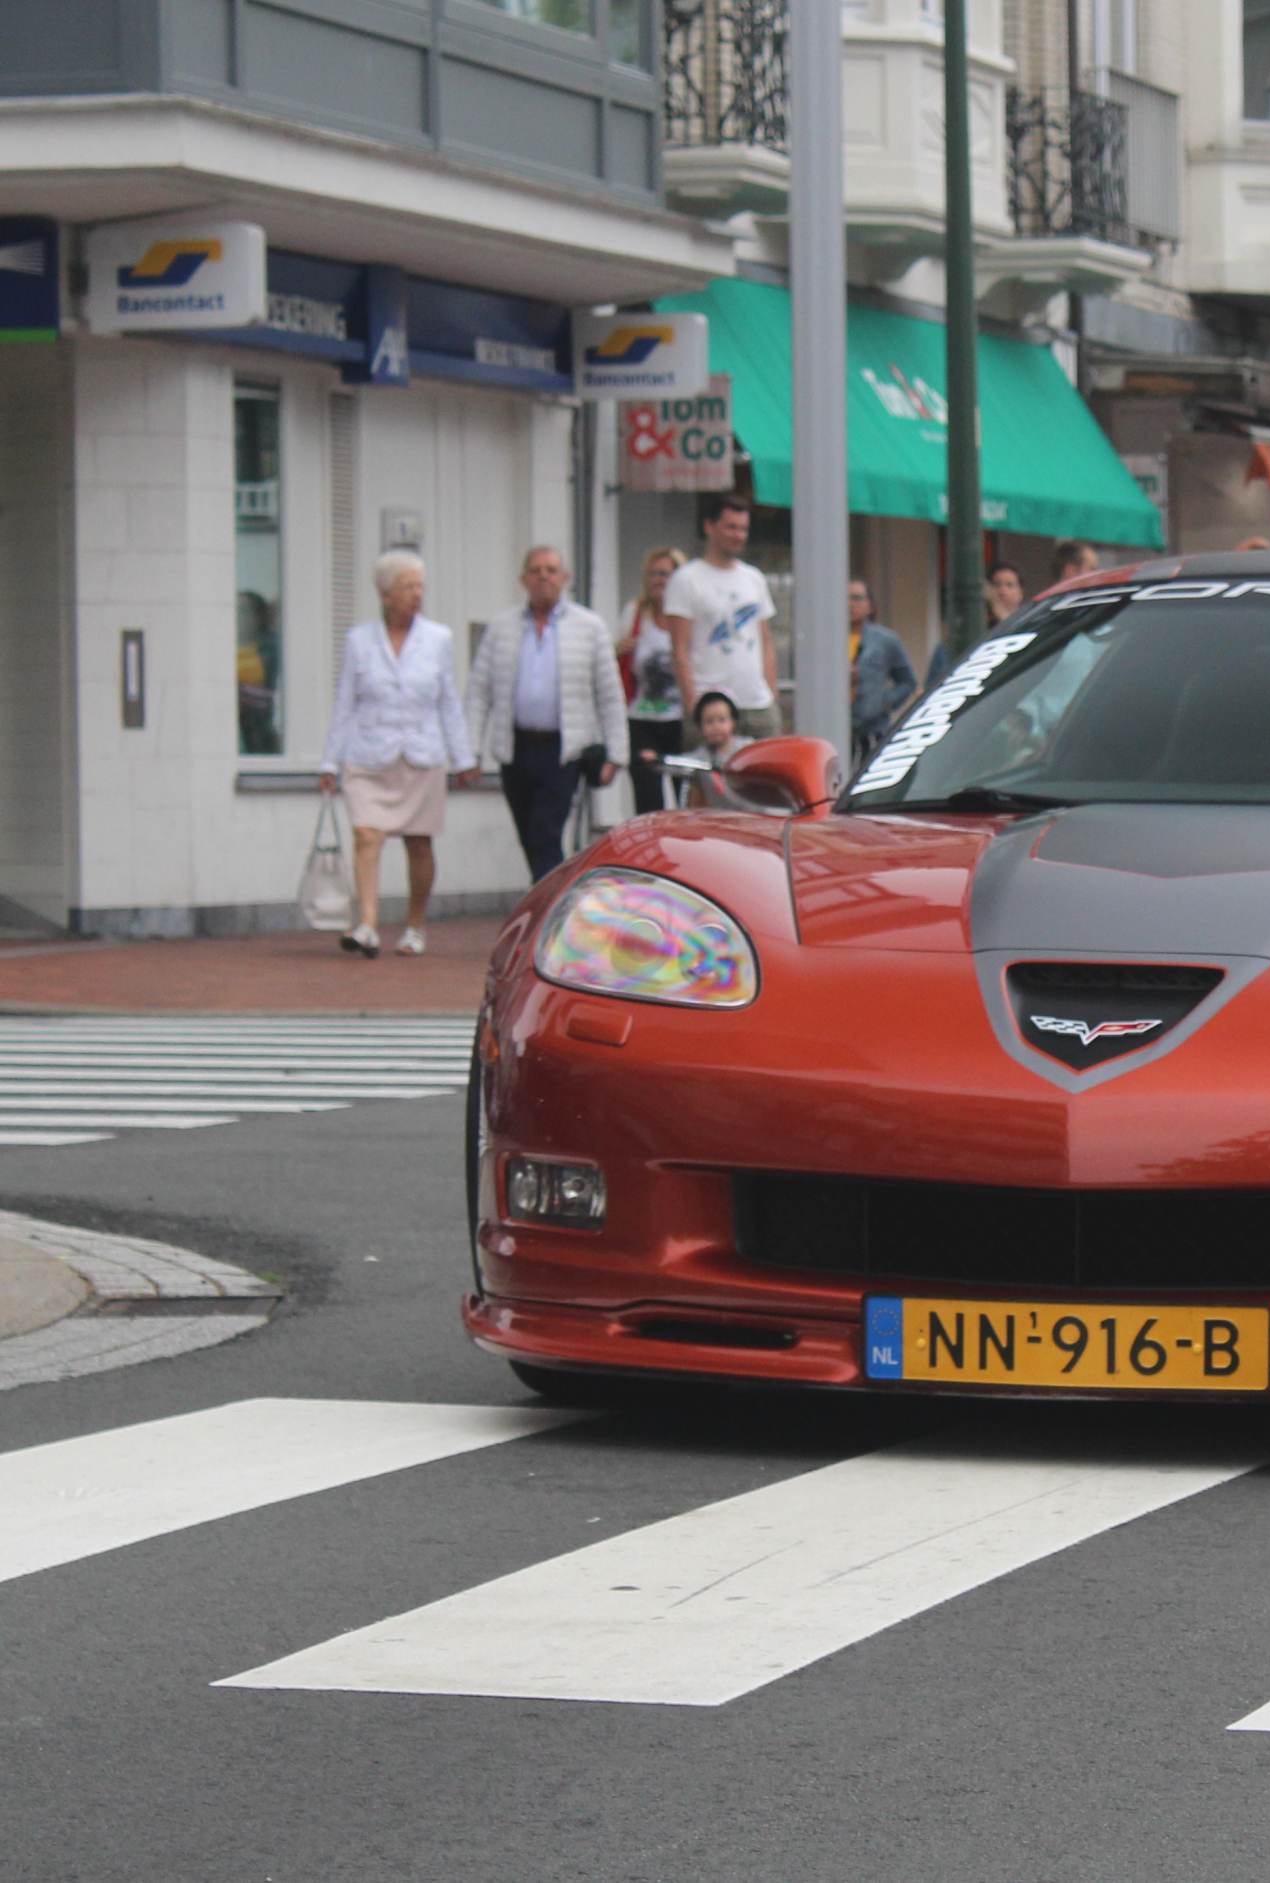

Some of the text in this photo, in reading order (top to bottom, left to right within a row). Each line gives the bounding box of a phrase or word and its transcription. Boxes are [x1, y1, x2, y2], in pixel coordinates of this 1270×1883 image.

[117, 295, 225, 313] Bancontact
[585, 372, 675, 387] Bancontact
[680, 428, 727, 462] Co
[872, 1347, 898, 1366] NL
